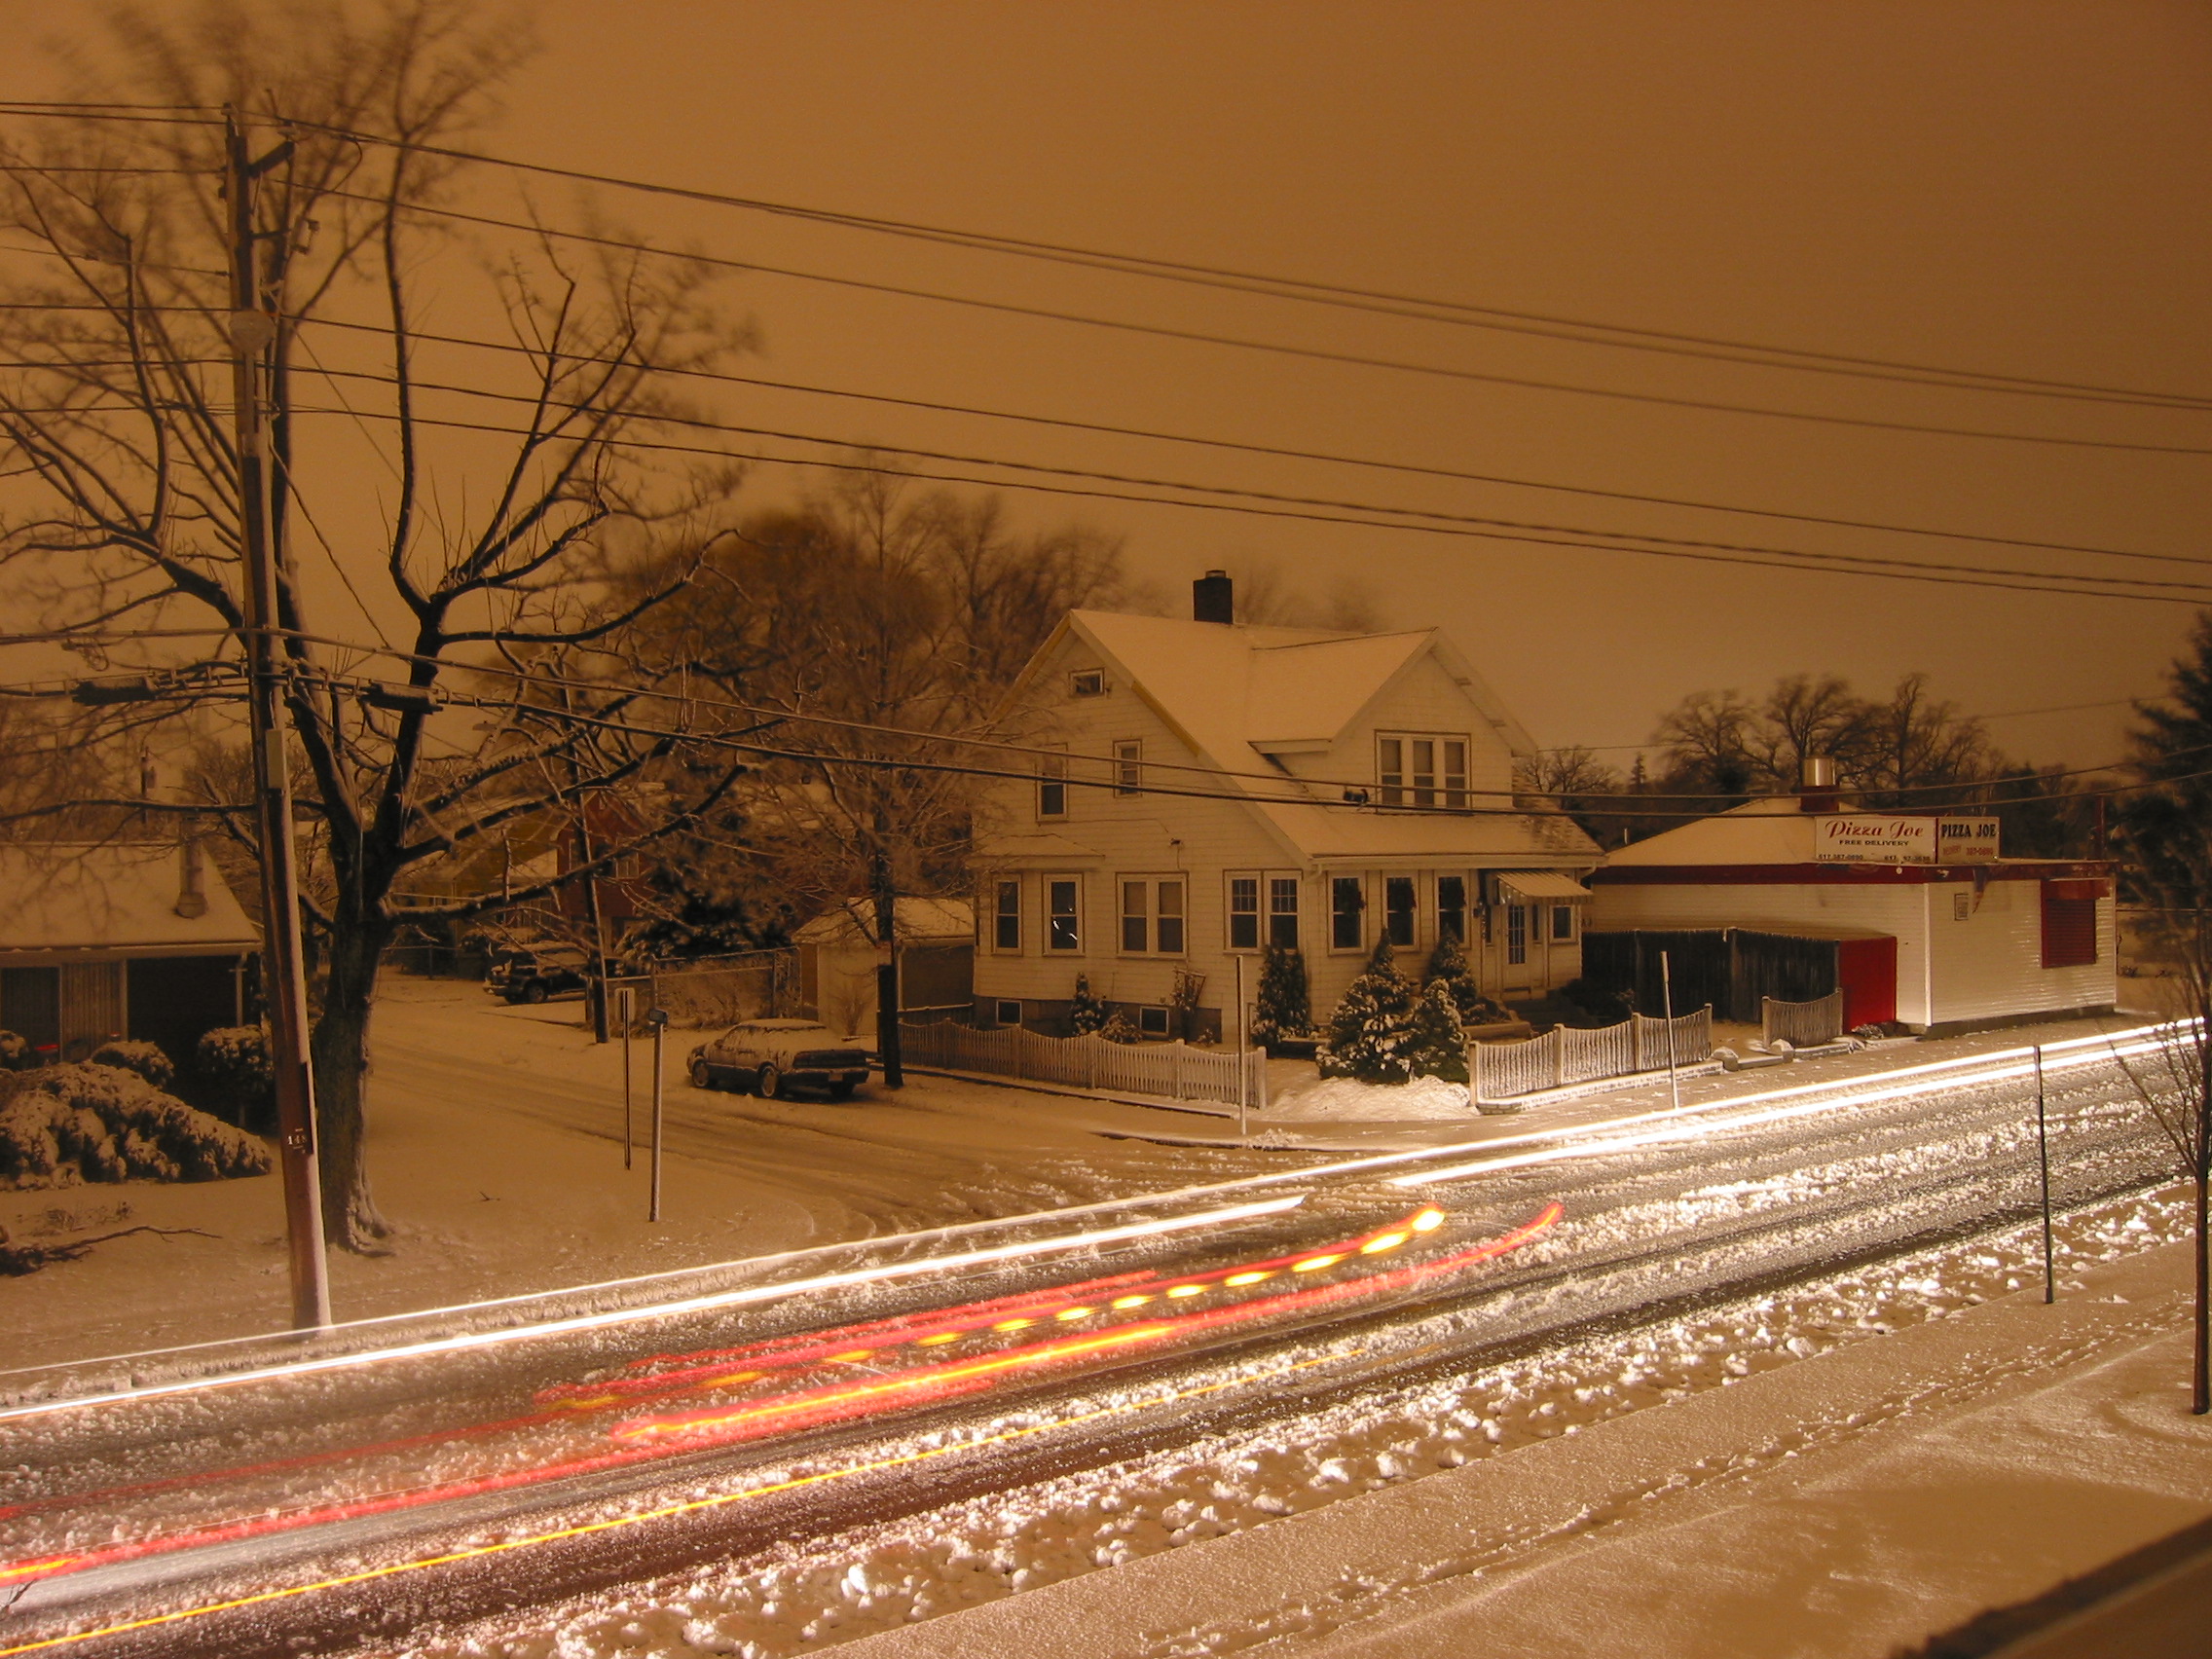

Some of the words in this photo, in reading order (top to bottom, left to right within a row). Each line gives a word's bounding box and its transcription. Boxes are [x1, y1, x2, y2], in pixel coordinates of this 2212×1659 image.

[1825, 820, 1884, 838] Pizza
[1890, 821, 1924, 839] Joe
[1941, 824, 1972, 837] PIZZA
[1976, 824, 1996, 837] JOE
